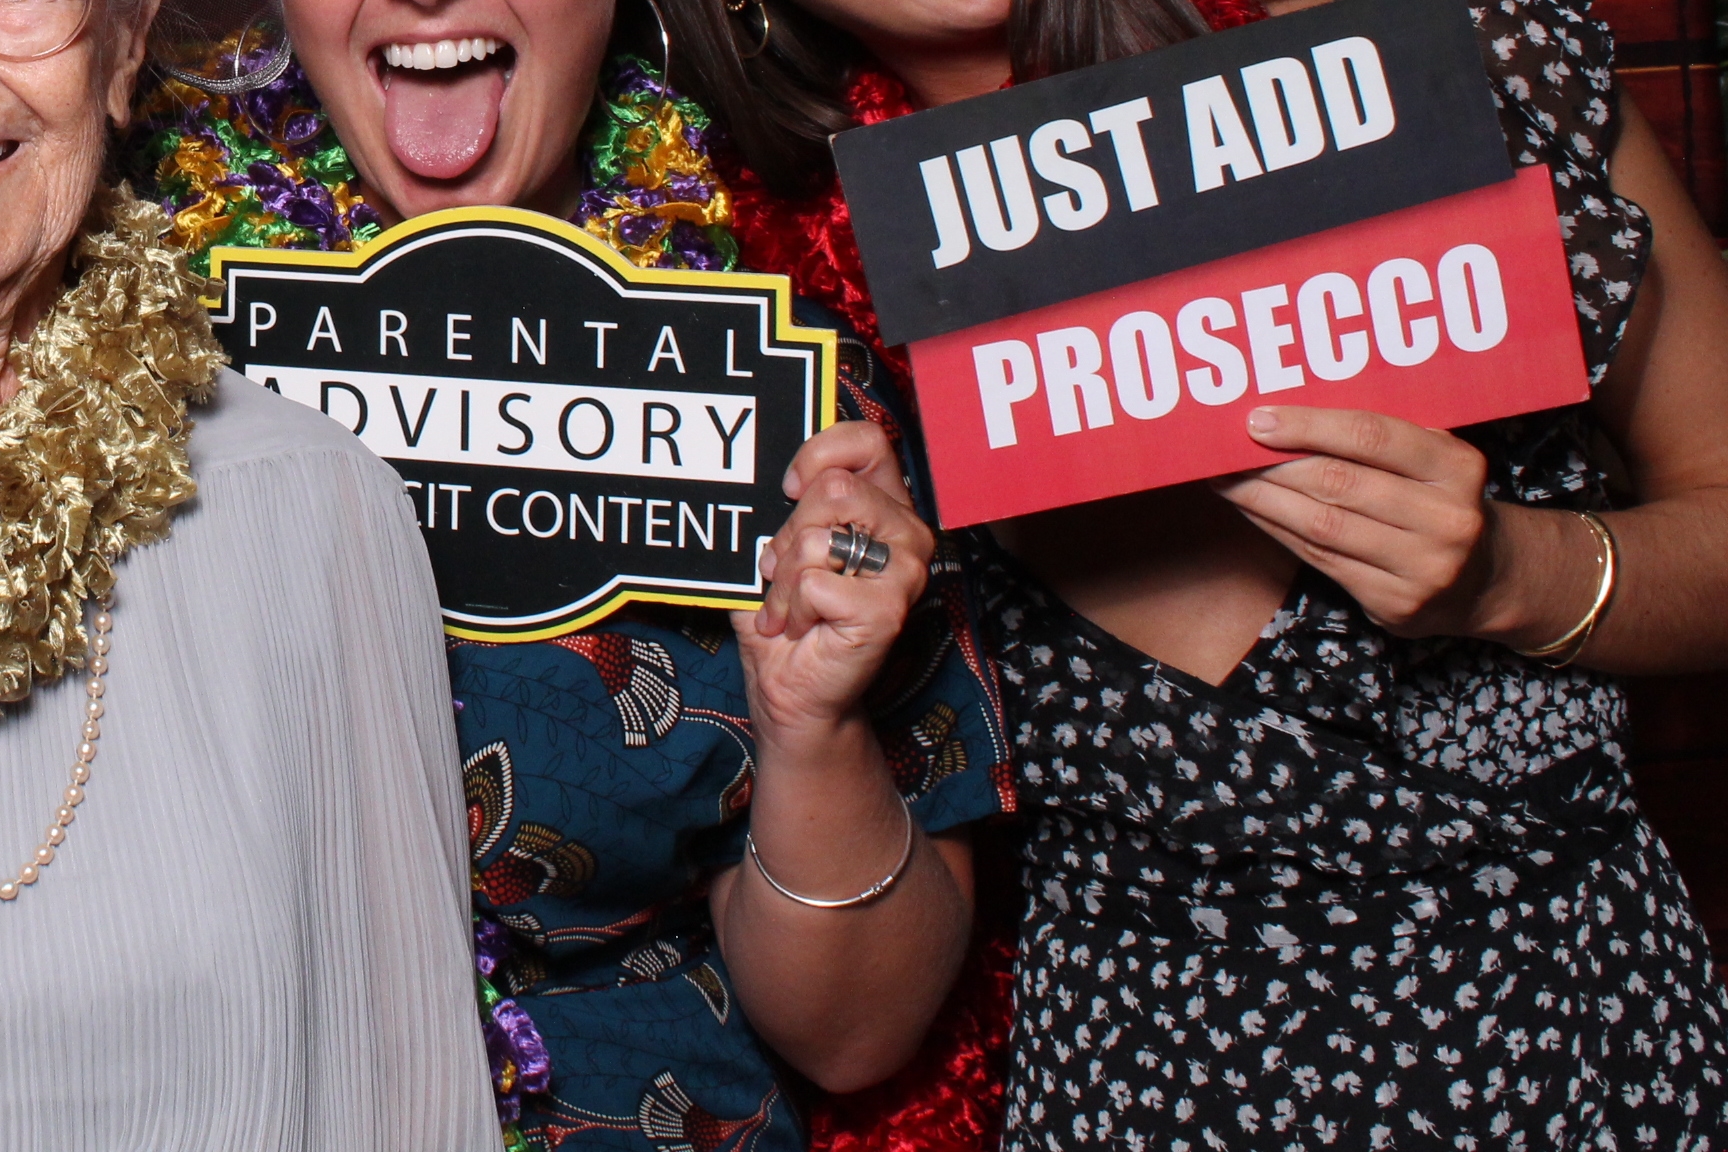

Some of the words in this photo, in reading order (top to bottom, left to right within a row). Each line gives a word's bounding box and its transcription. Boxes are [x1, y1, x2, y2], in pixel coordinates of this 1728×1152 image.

[918, 96, 1160, 271] JUST
[1182, 35, 1396, 194] ADD
[248, 301, 754, 379] PARENTAL
[971, 243, 1509, 451] PROSECCO
[262, 377, 755, 471] DVISORY
[485, 487, 754, 553] CONTENT
